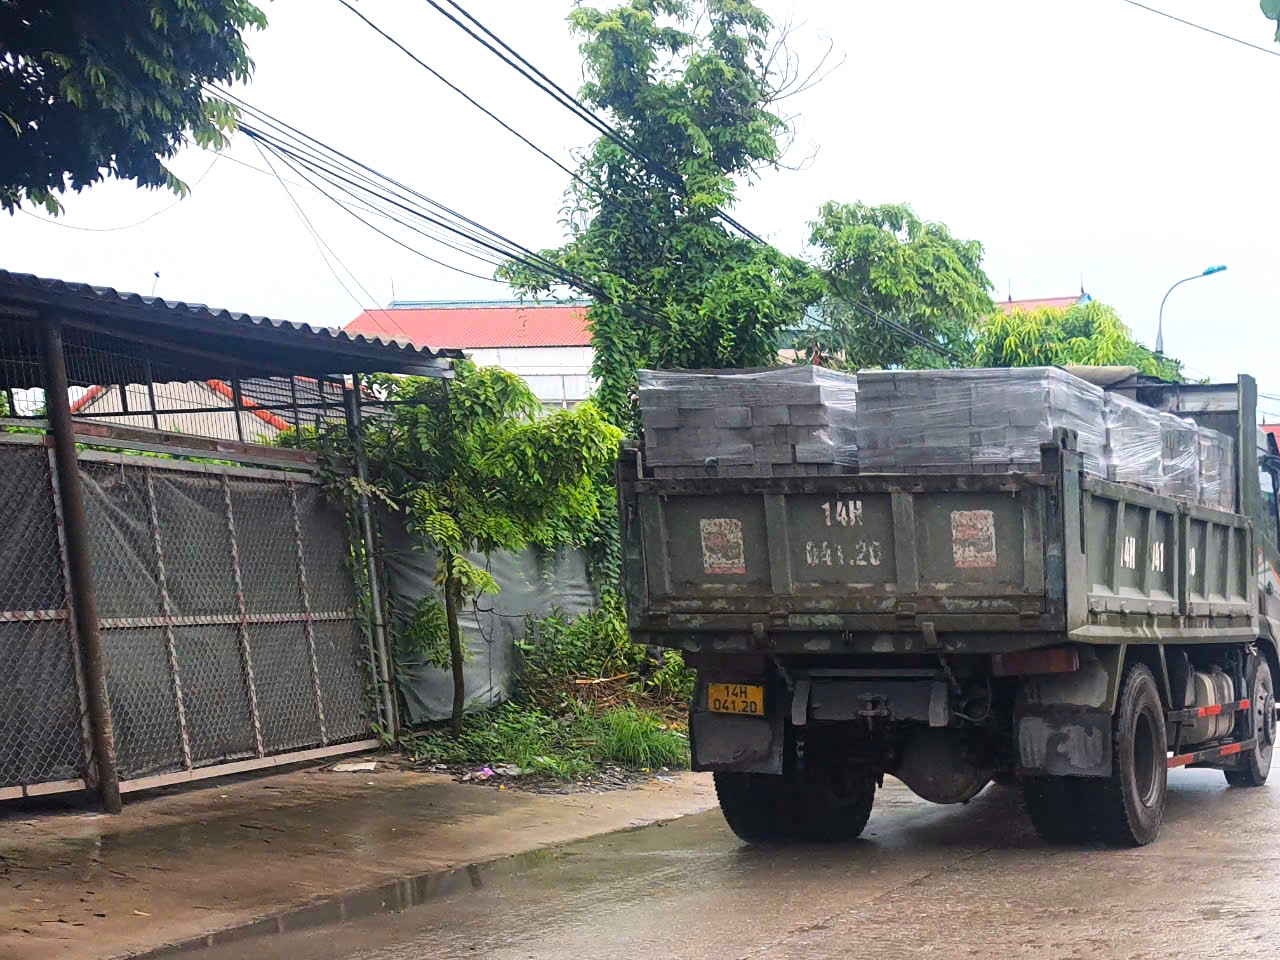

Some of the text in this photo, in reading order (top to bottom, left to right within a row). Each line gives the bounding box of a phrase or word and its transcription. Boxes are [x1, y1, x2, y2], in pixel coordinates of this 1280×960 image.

[821, 500, 863, 527] 14H
[724, 685, 748, 698] 14H
[713, 698, 758, 713] 041.20
